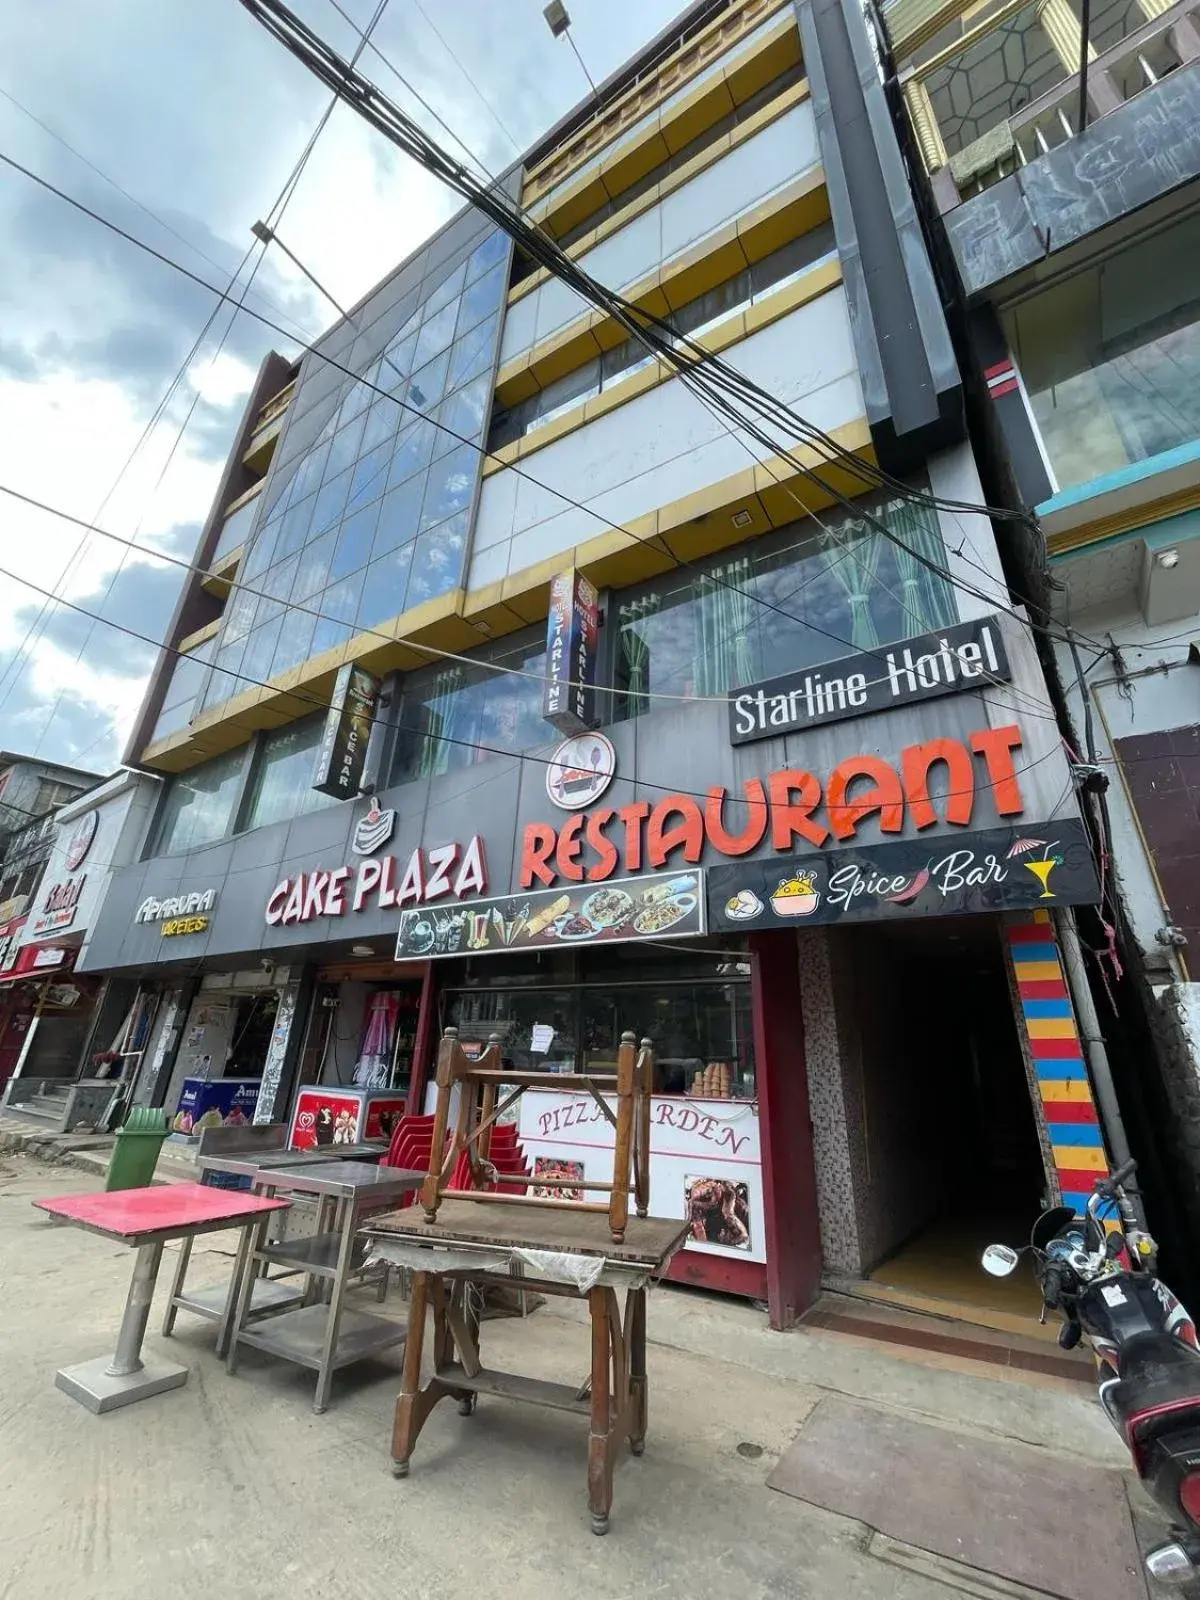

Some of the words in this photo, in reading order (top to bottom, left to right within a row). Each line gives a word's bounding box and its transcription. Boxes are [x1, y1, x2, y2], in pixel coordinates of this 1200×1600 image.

[548, 613, 564, 712] STARLINE
[576, 620, 588, 718] STARLINE
[735, 673, 868, 735] Starline
[887, 627, 1000, 697] Hotel
[338, 755, 353, 788] BAR
[519, 724, 1025, 889] RESTAURANT
[264, 866, 353, 927] CAKE
[352, 834, 489, 912] PLAZA
[827, 864, 911, 912] Spice
[932, 849, 1009, 896] Bar
[235, 1084, 260, 1098] Am
[650, 1103, 750, 1154] RDEN
